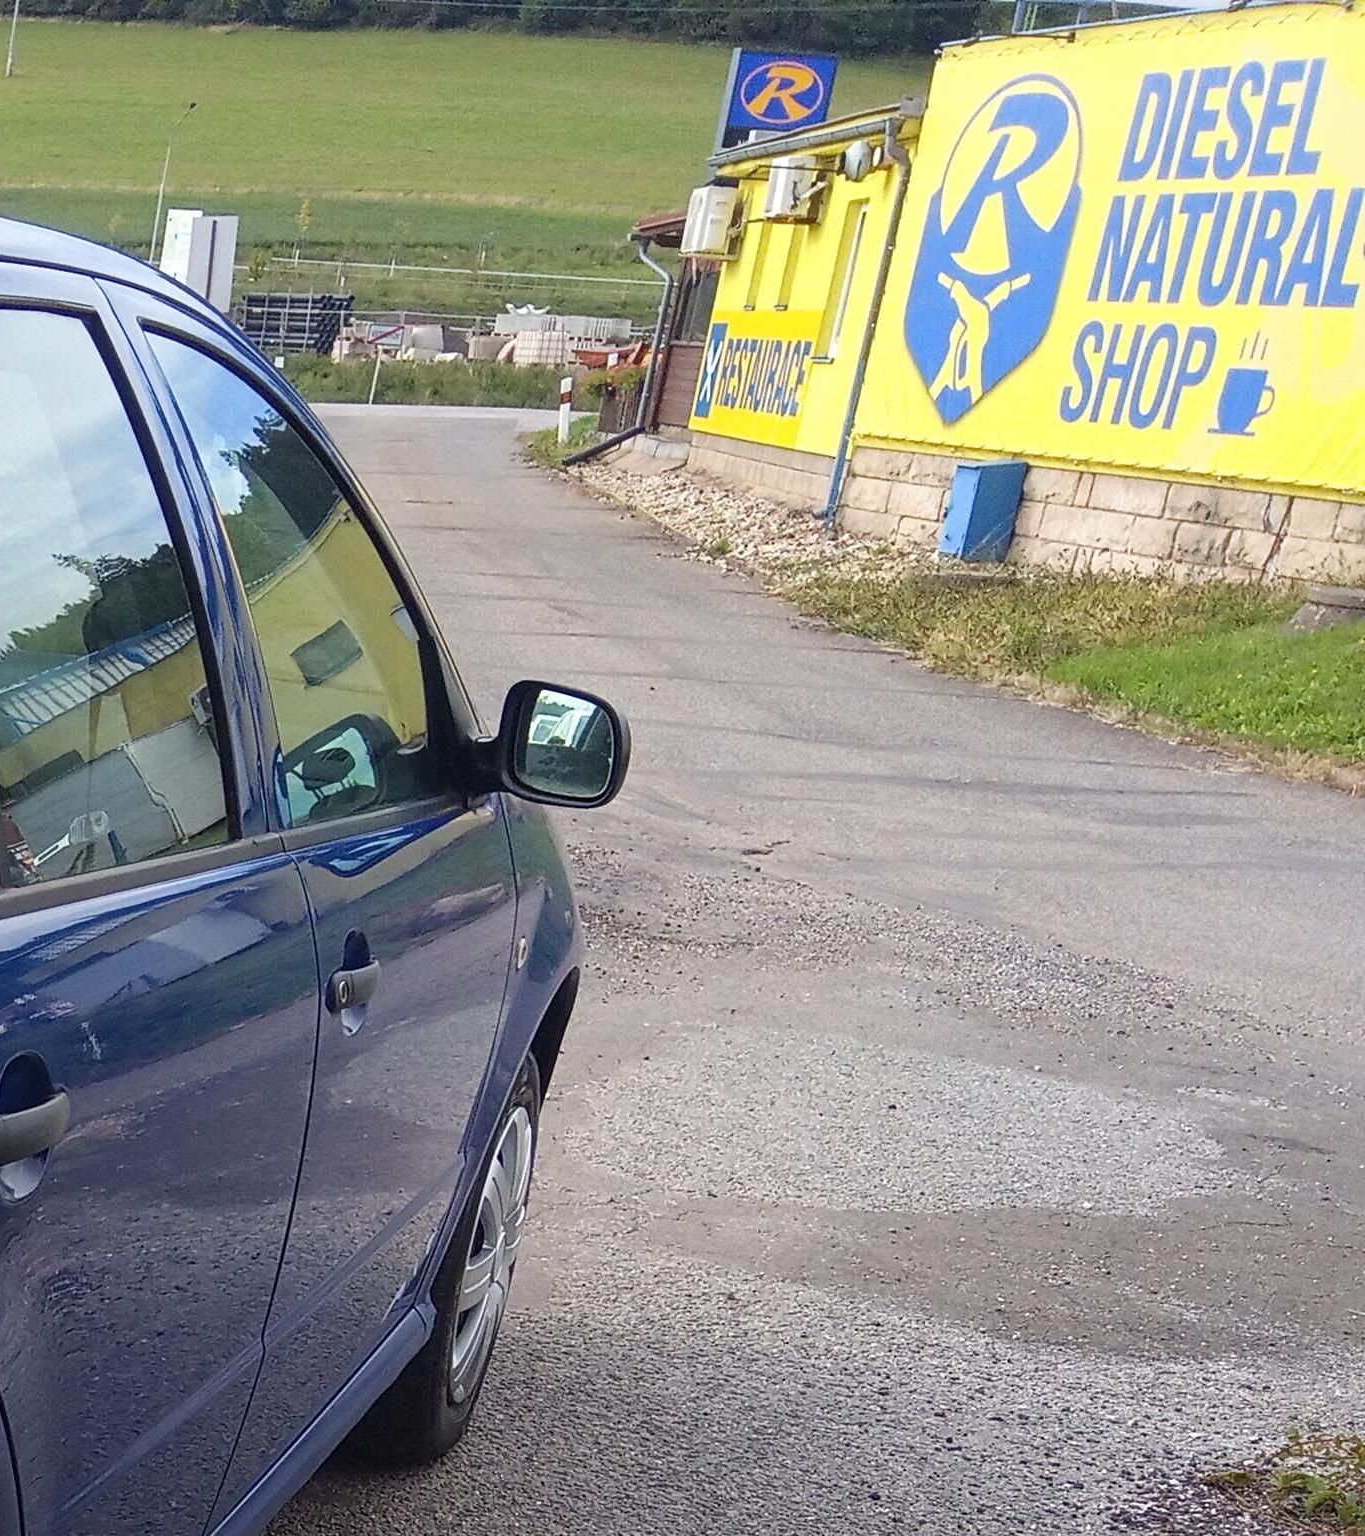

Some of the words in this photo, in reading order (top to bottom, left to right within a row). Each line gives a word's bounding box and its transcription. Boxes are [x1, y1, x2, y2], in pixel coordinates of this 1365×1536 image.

[747, 66, 815, 121] R
[1117, 57, 1327, 182] DIESEL
[1087, 187, 1365, 308] NATURAL
[715, 338, 813, 417] RESTAURACE
[1059, 321, 1218, 431] SHOP
